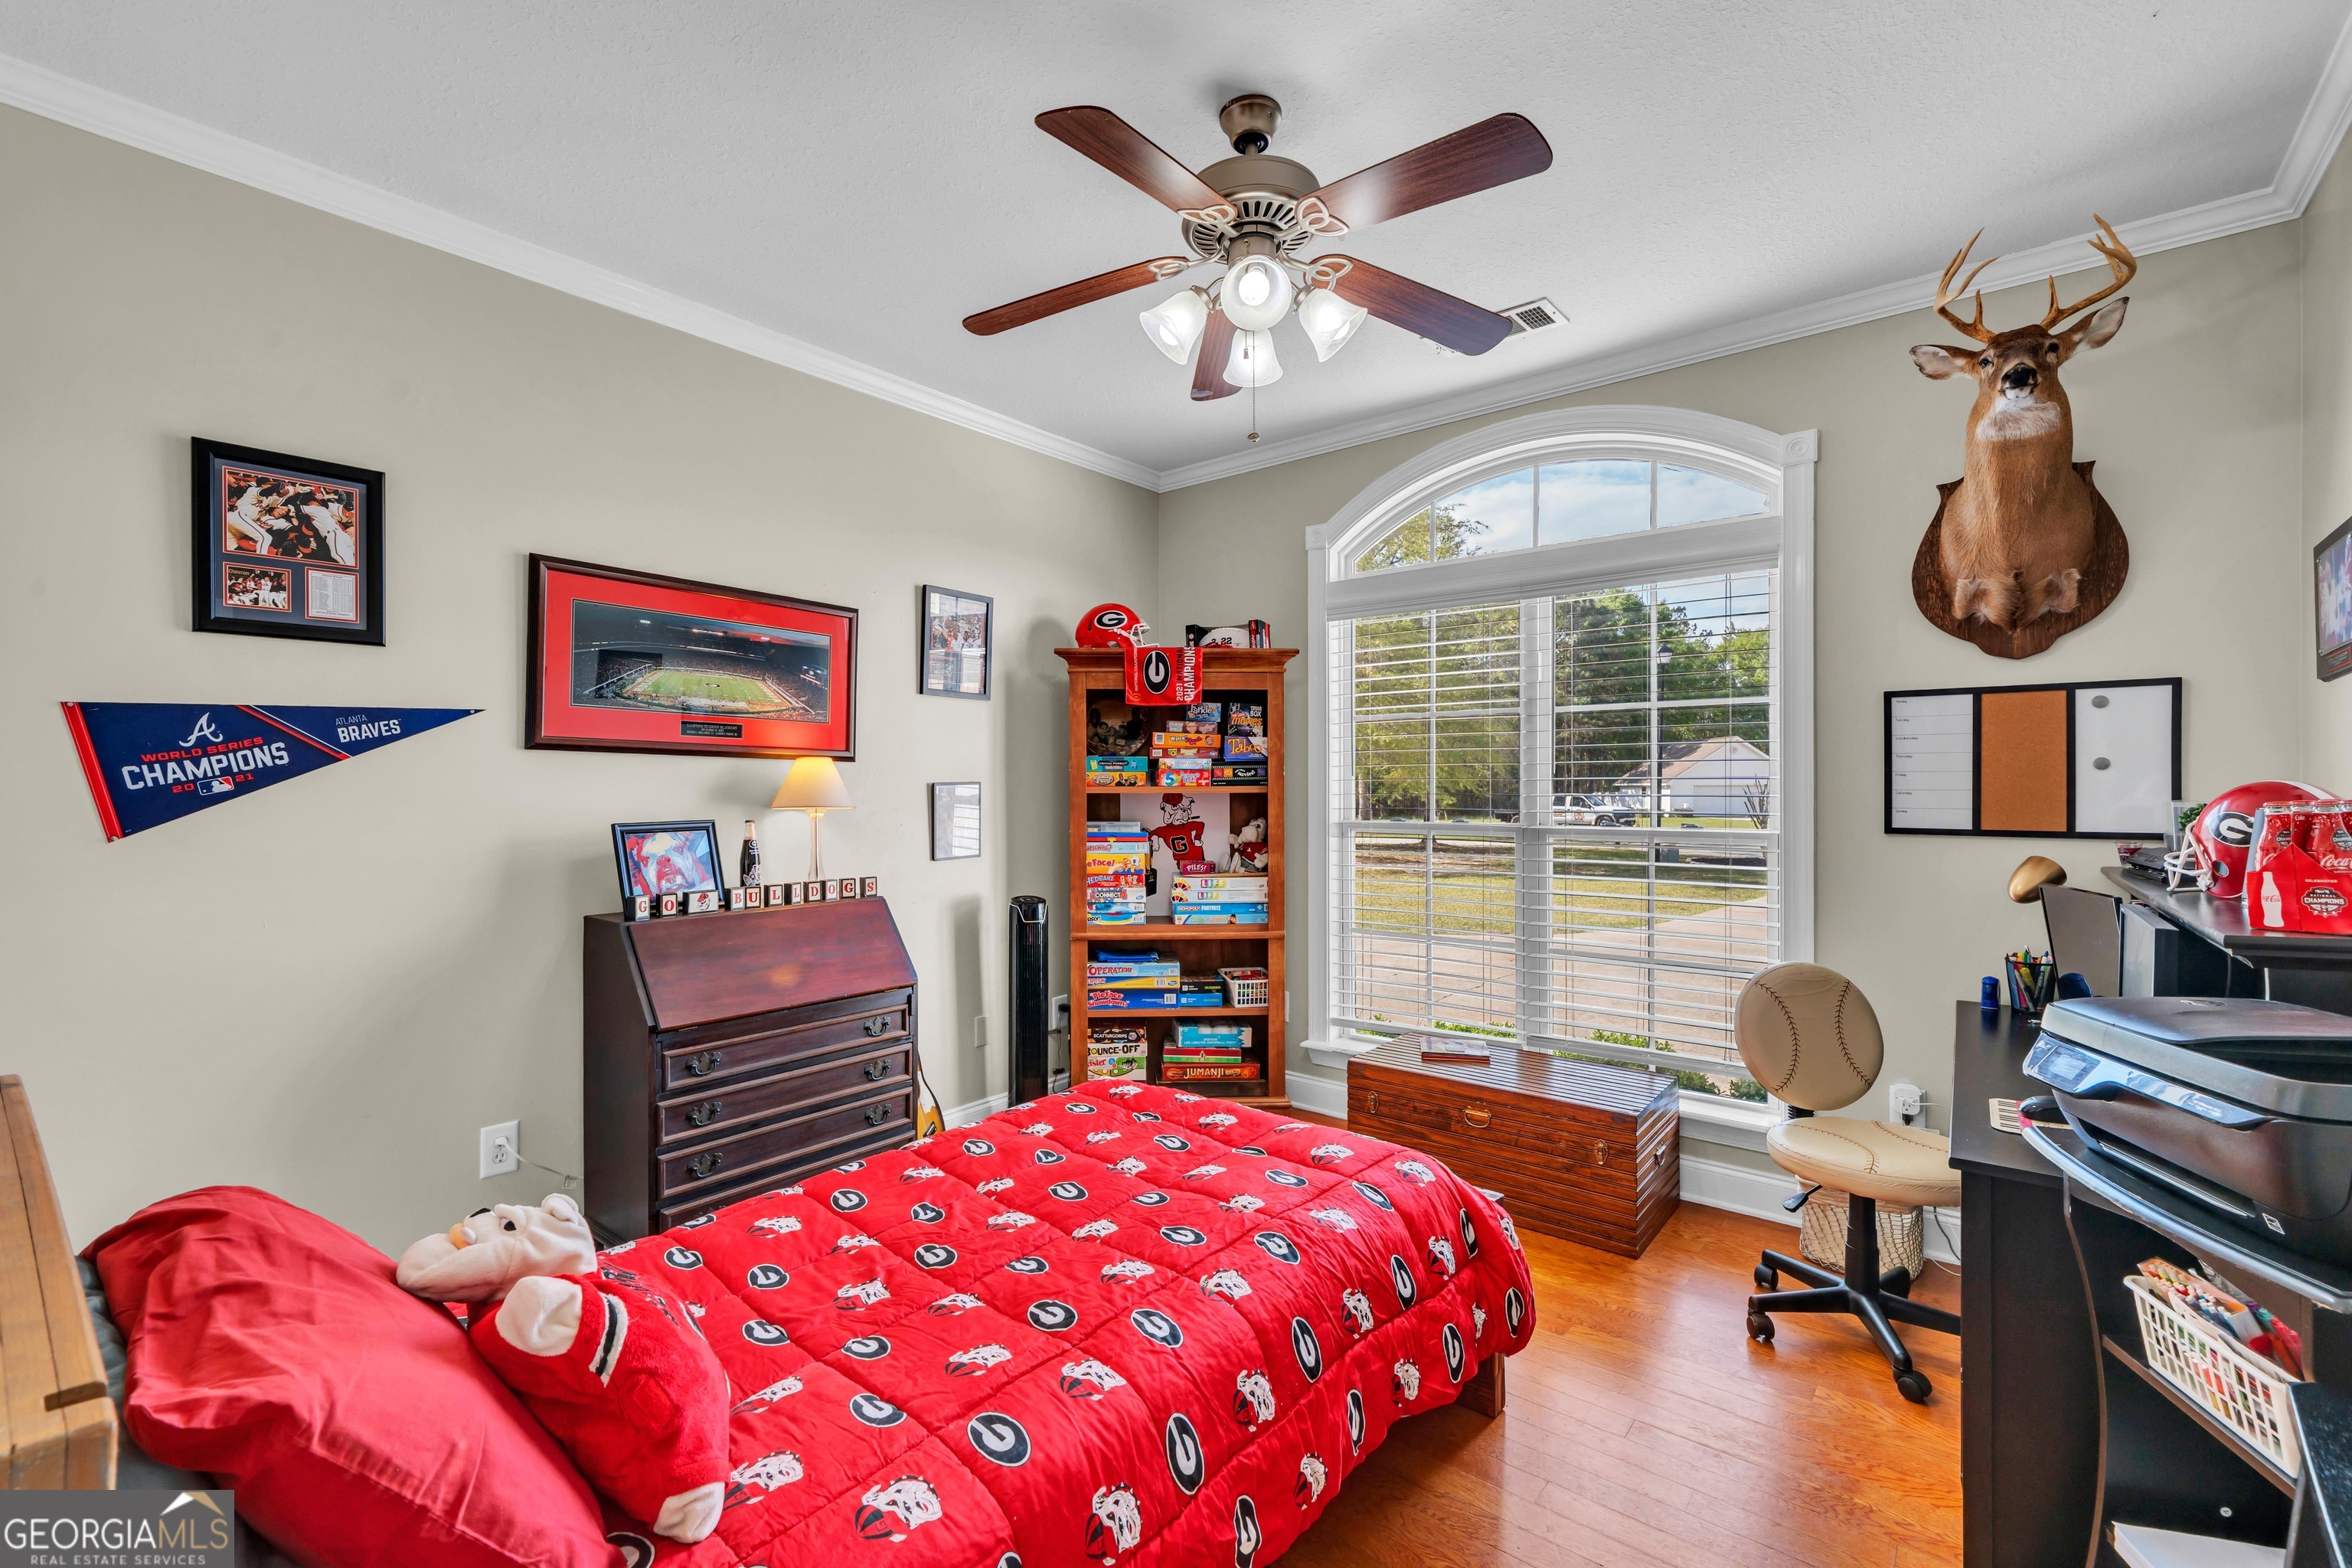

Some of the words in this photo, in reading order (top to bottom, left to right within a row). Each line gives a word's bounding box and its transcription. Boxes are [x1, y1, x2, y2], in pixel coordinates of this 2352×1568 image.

[1094, 610, 1128, 629] G
[1143, 650, 1171, 694] G
[1191, 704, 1213, 714] Farkle
[335, 714, 368, 726] ATLANTA
[337, 719, 401, 743] BRAVES
[141, 747, 202, 762] WORLD
[207, 737, 263, 753] SERIES
[1227, 738, 1263, 754] Taboo
[122, 742, 289, 790] CHAMPIONS
[172, 783, 194, 793] 20
[235, 773, 253, 782] 21
[1170, 835, 1188, 854] G
[1187, 864, 1207, 872] PILES!
[1200, 879, 1227, 888] LIFE
[733, 880, 874, 904] BULLDOGS
[1120, 889, 1128, 900] 4
[1089, 966, 1132, 976] OPERATION
[1090, 991, 1105, 1000] Pie
[1105, 990, 1124, 999] Face
[1087, 998, 1129, 1008] Showdown!
[1088, 1044, 1140, 1056] BOUNCE-OFF
[1088, 1059, 1106, 1067] ister
[1184, 1068, 1224, 1079] JUMANJI
